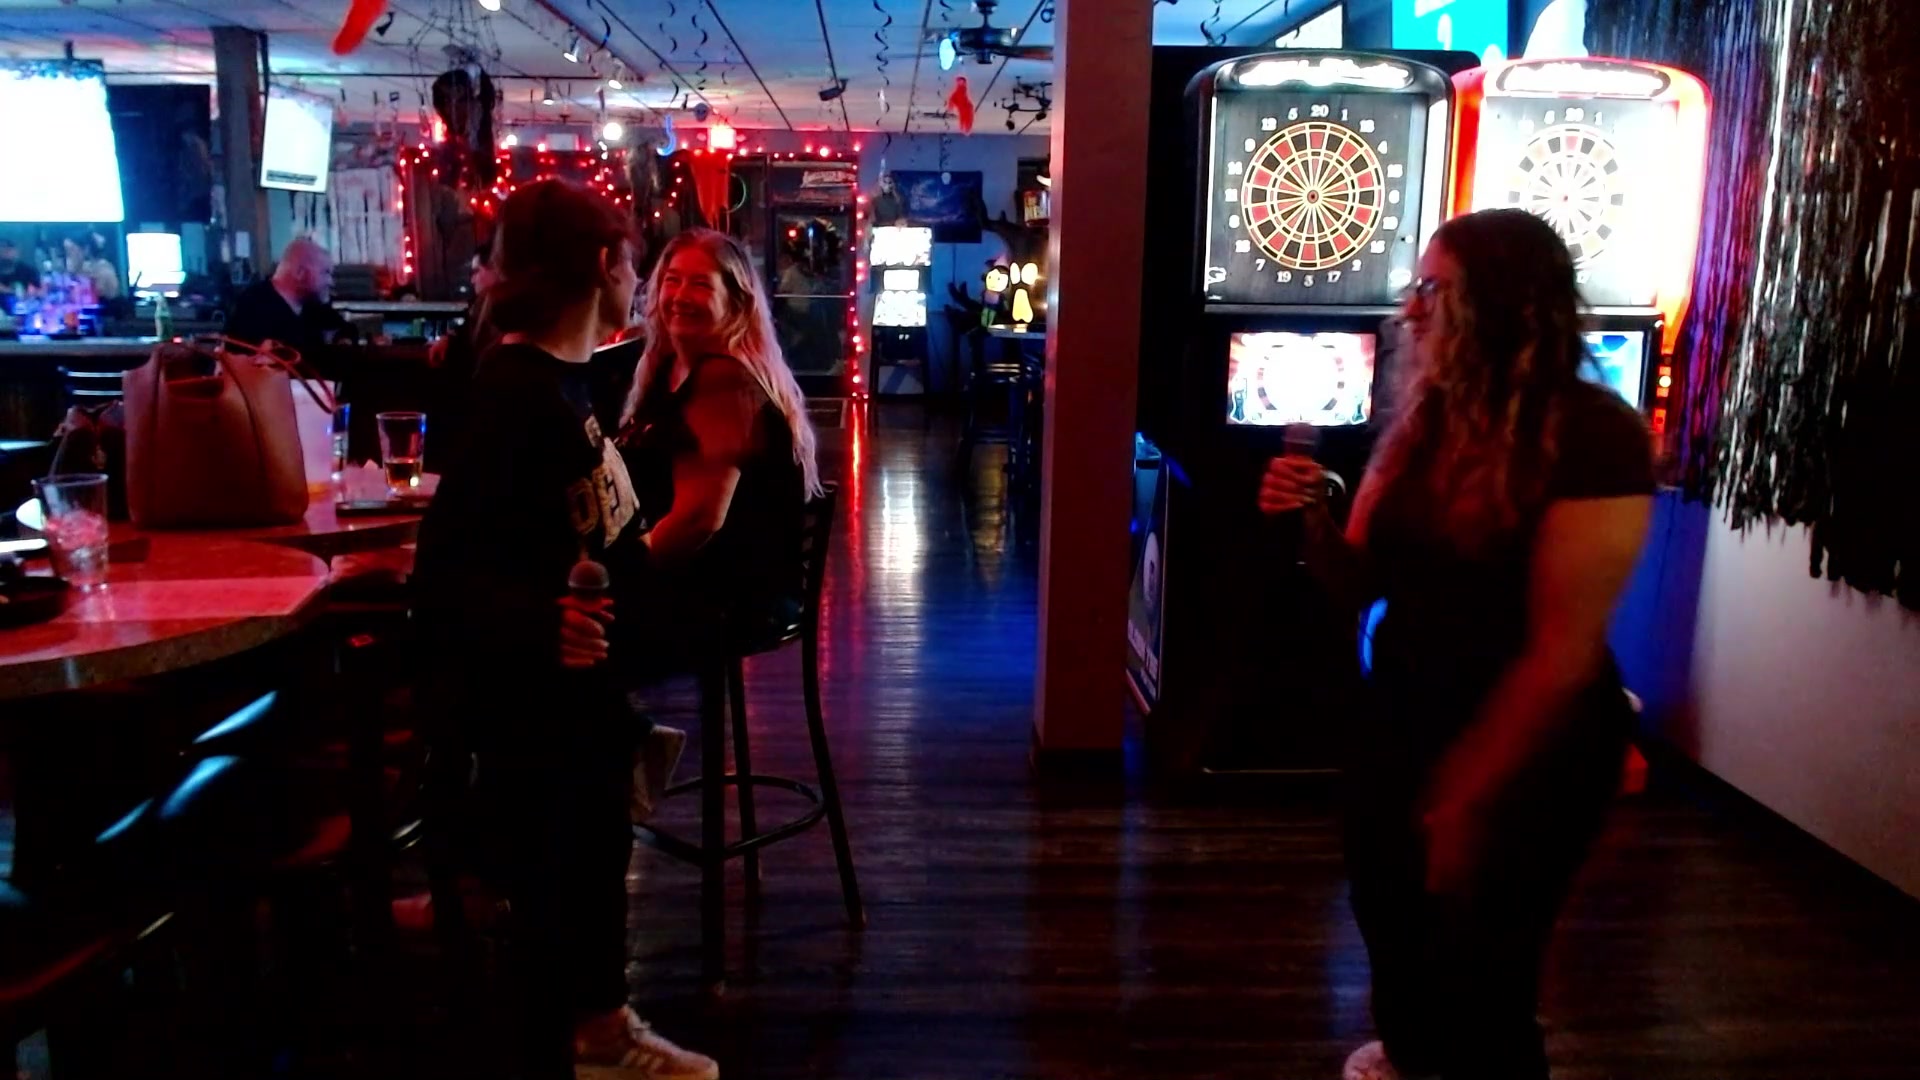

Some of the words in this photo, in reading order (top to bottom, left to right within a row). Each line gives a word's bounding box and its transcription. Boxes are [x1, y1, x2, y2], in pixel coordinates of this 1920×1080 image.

[1311, 104, 1329, 118] 20
[1341, 108, 1349, 121] 1
[1255, 258, 1266, 272] 7
[1276, 270, 1292, 283] 19
[1327, 270, 1342, 283] 17
